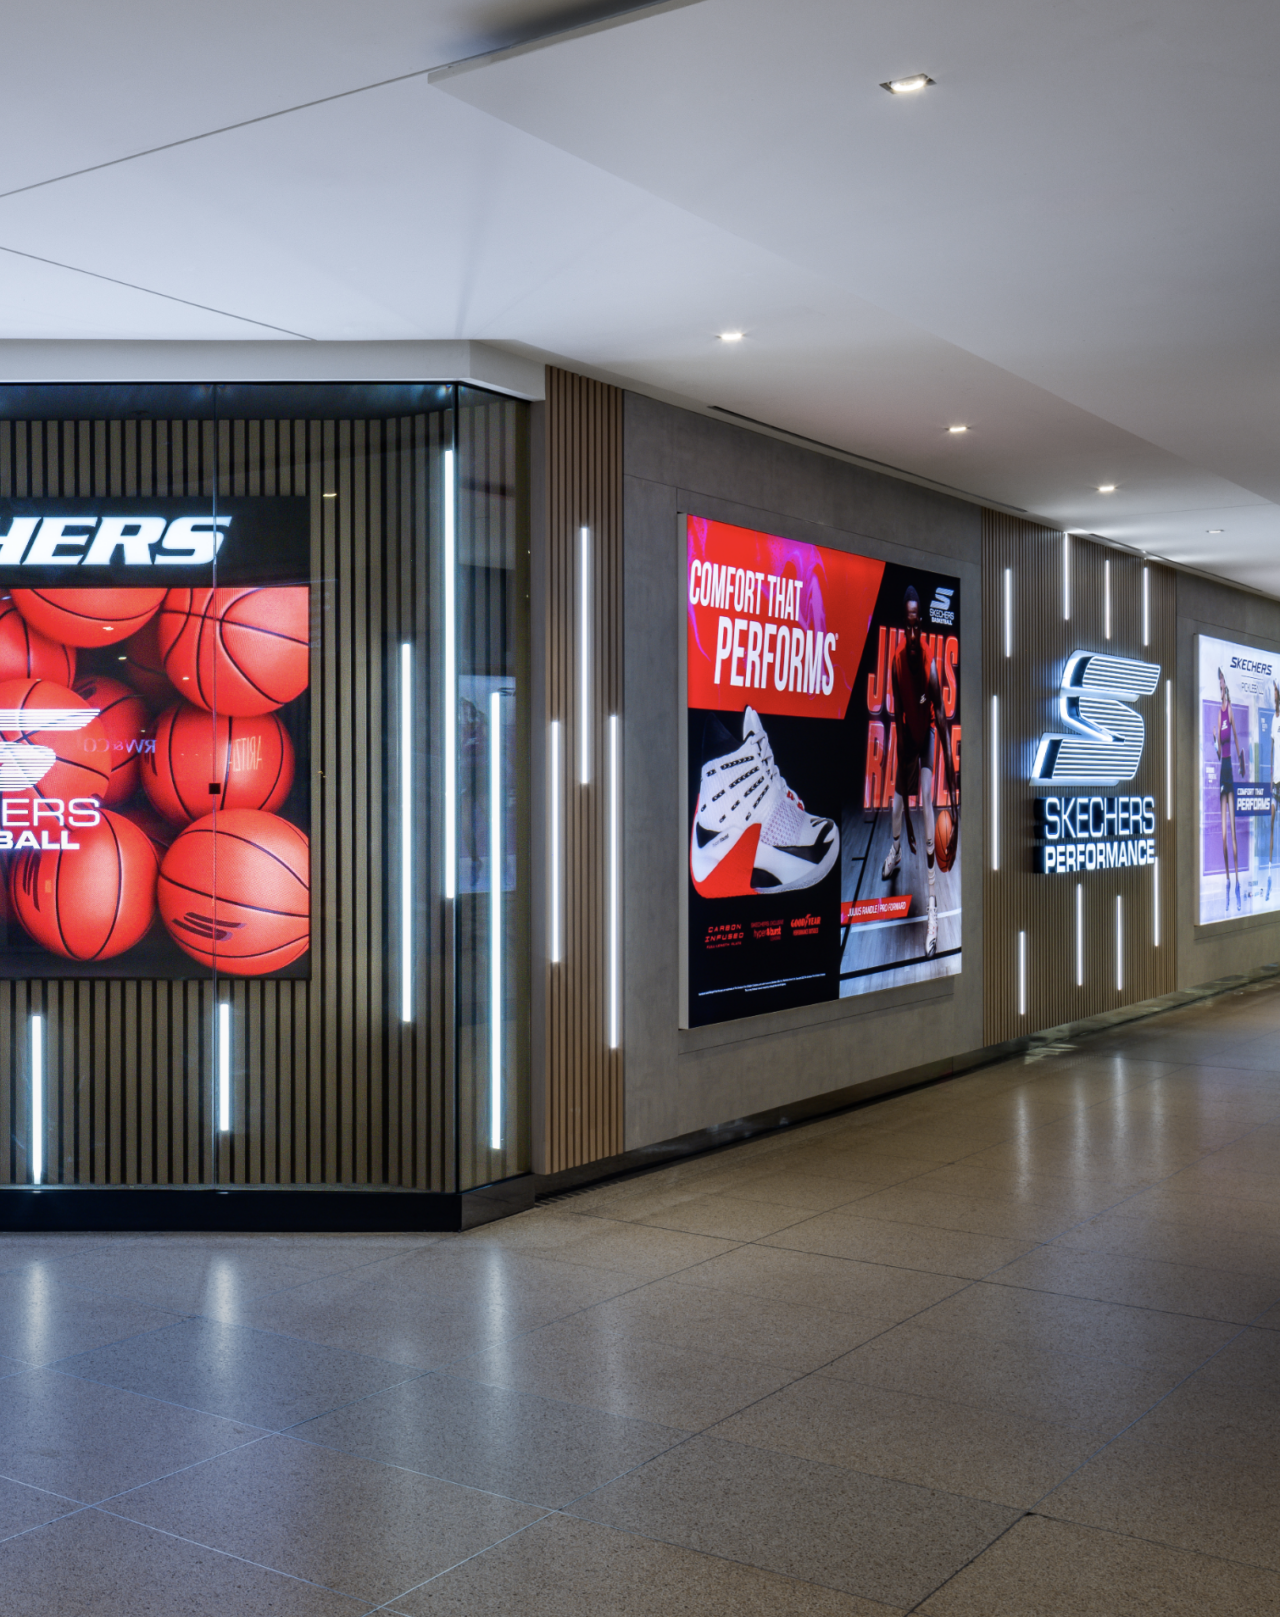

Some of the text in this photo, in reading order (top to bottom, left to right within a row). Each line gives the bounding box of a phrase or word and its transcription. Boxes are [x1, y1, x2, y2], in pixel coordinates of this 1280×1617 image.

[689, 558, 803, 621] COMFORT THAT
[713, 616, 837, 697] PERFORMS
[1230, 656, 1272, 676] SKECHERS
[1044, 796, 1155, 840] SKECHERS
[1044, 839, 1155, 875] PERFORMANCE
[705, 932, 744, 943] INFUSED
[708, 924, 741, 933] CARBON
